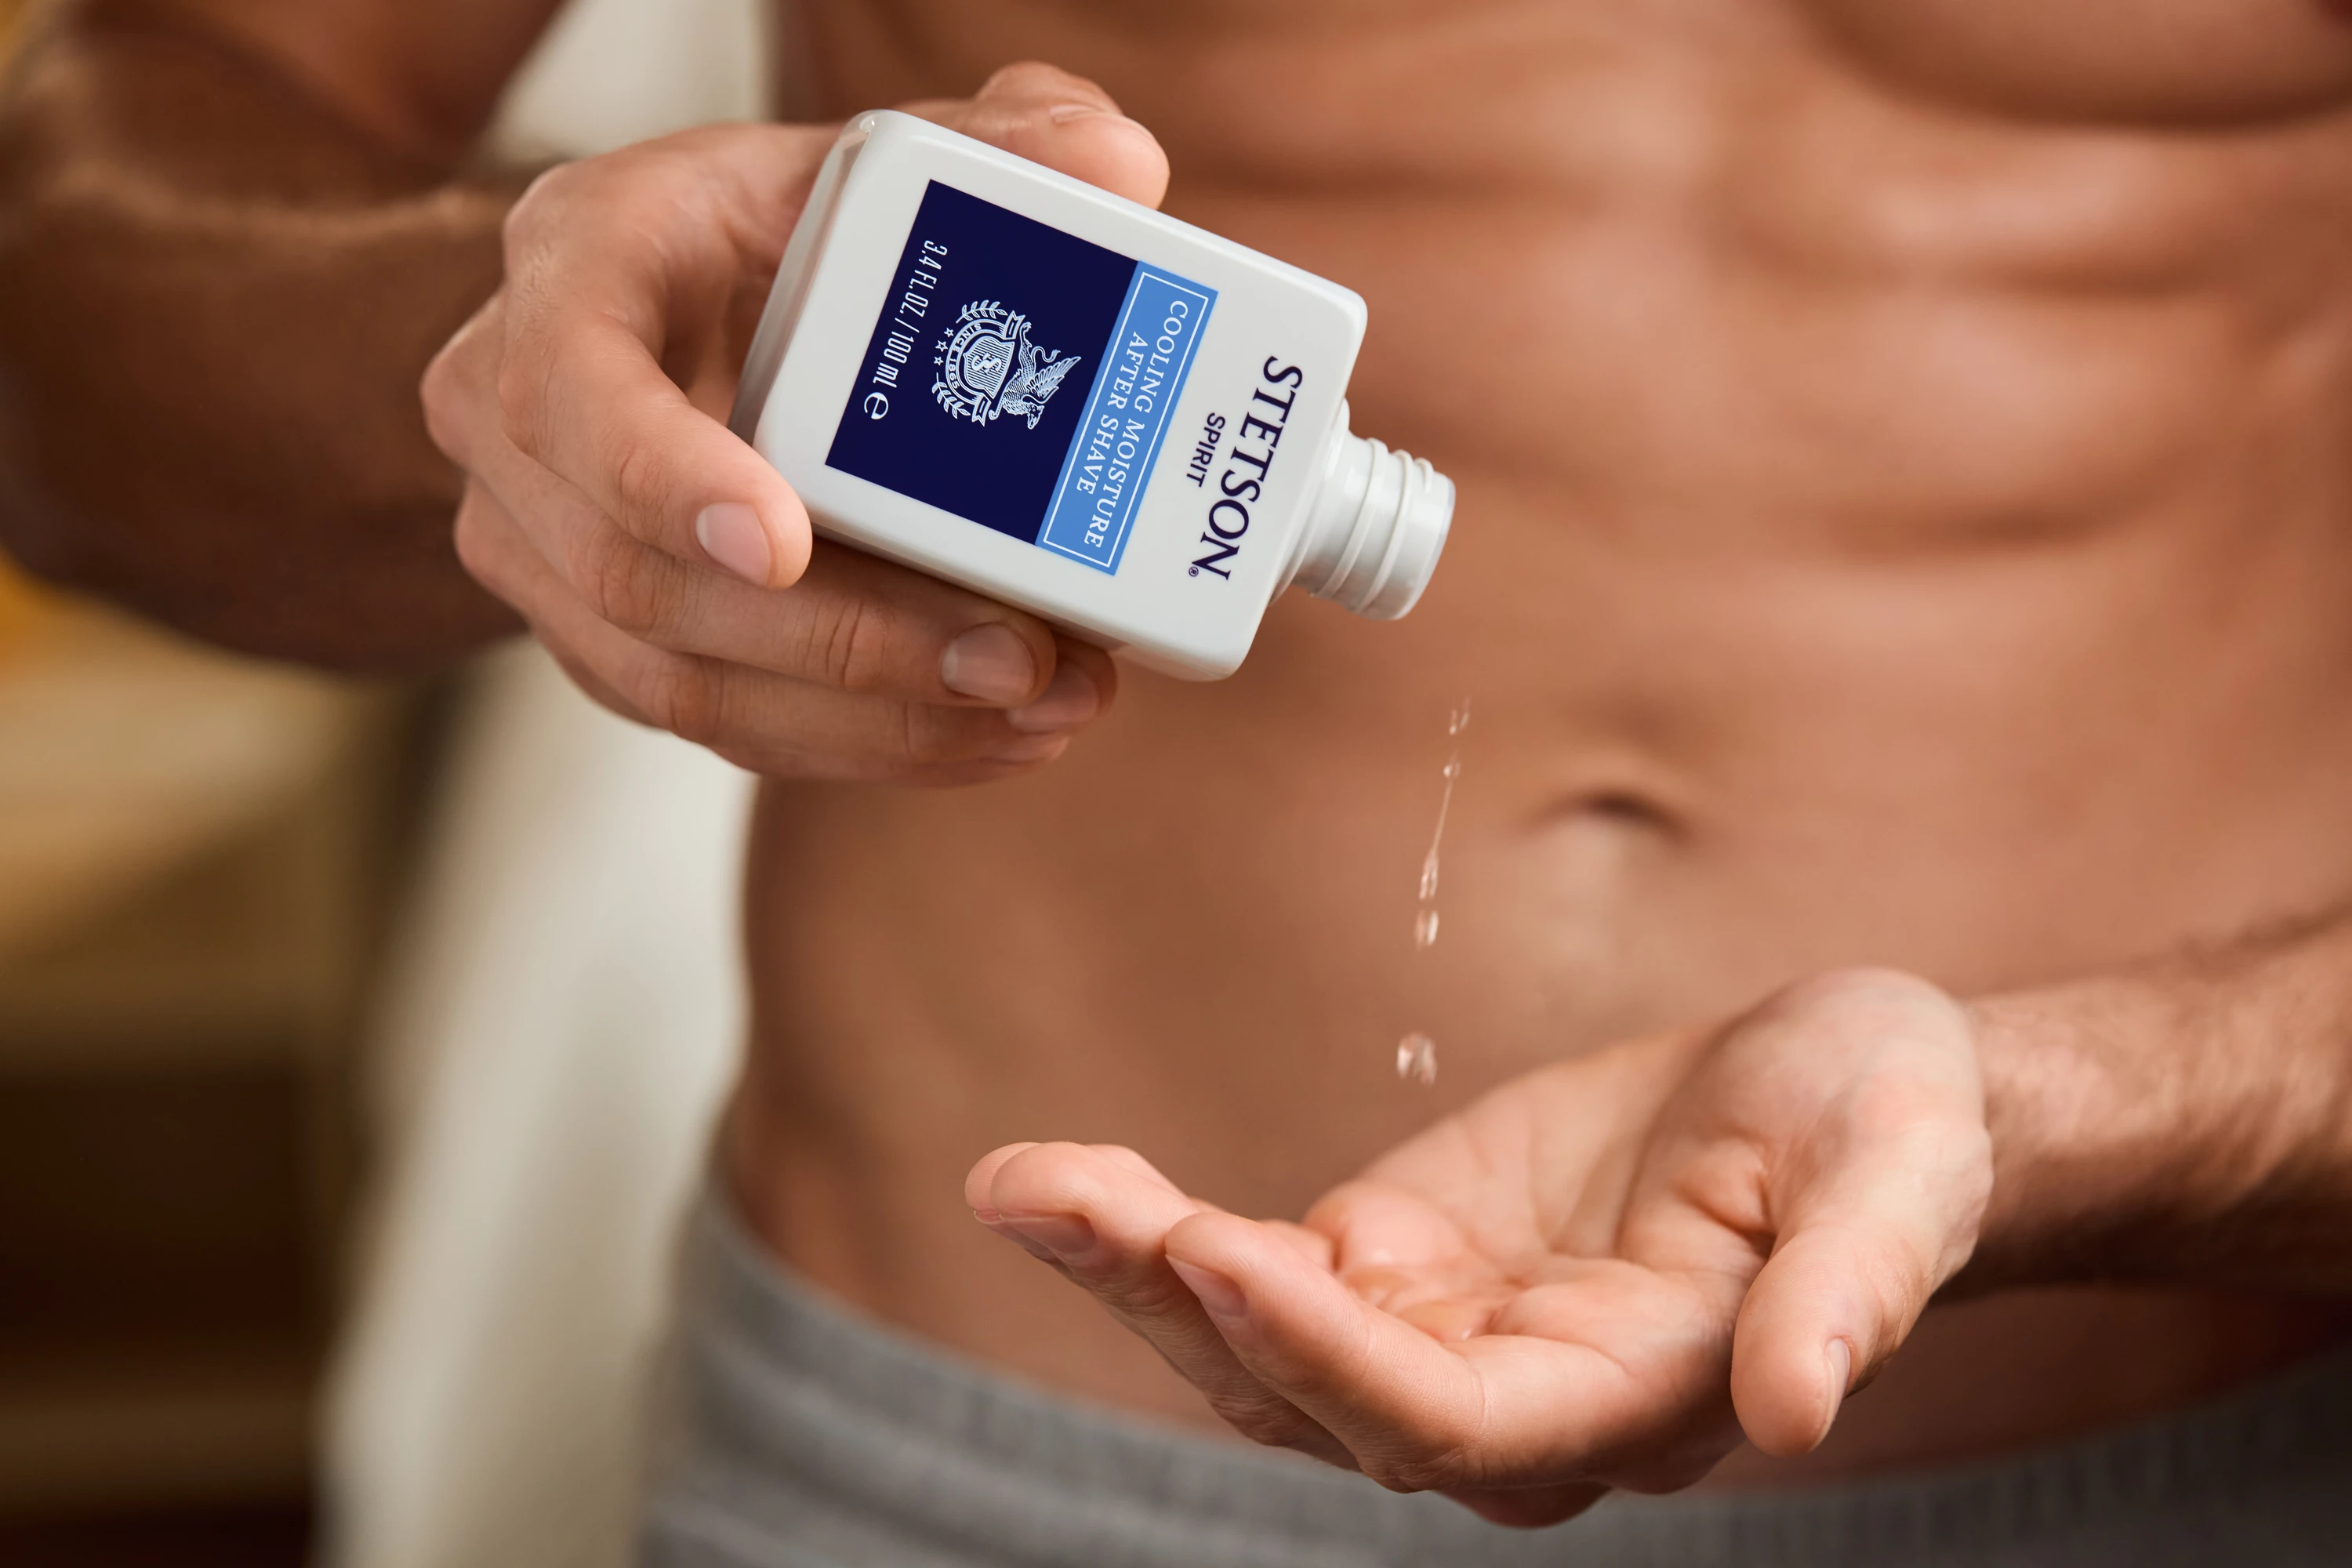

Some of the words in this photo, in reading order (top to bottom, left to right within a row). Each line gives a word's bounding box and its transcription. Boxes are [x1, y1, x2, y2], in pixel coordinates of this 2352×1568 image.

[918, 240, 948, 270] 3.4
[884, 331, 914, 364] 100
[895, 318, 920, 332] /
[953, 322, 982, 353] SINCE
[949, 358, 960, 390] 1865
[1107, 331, 1148, 410] AFTER
[1132, 300, 1189, 414] COOLING
[1076, 414, 1119, 495] SHAVE
[1186, 412, 1226, 488] SPIRIT
[1083, 417, 1145, 547] MOISTURE
